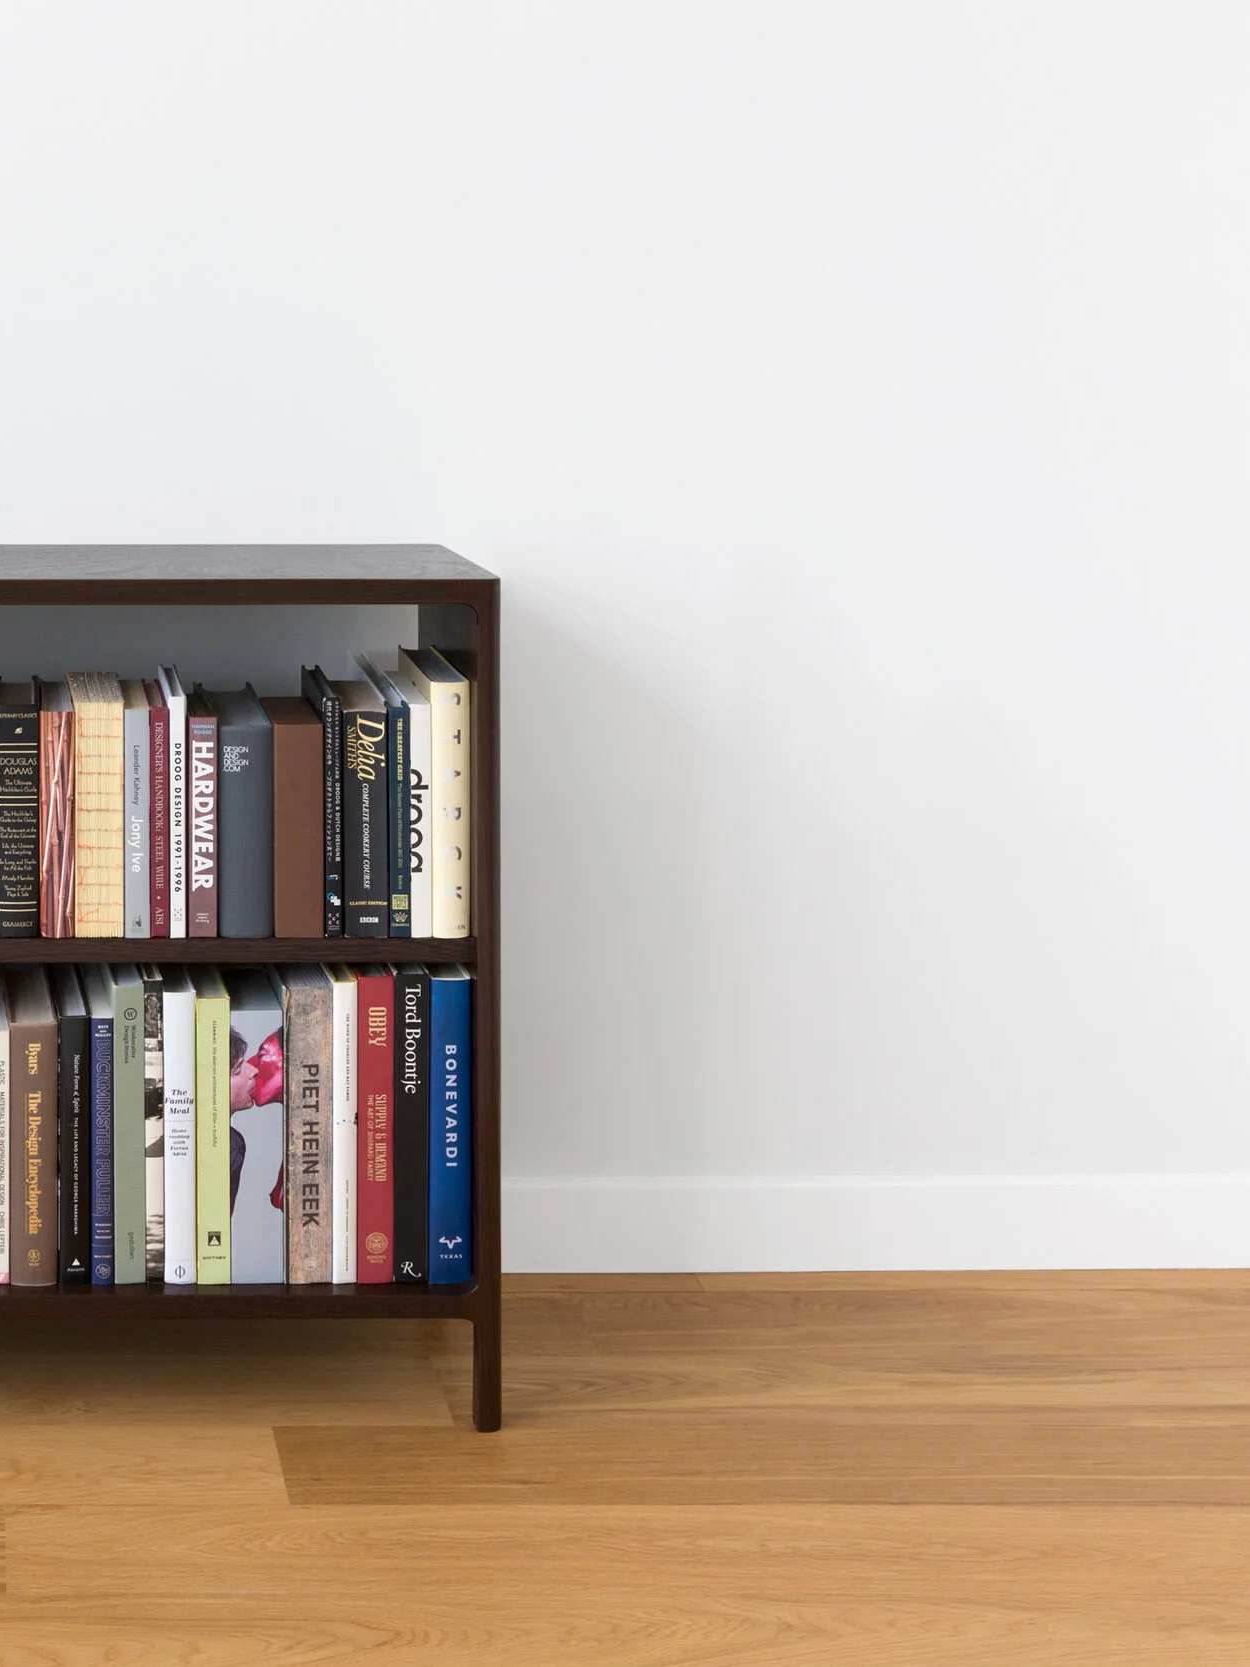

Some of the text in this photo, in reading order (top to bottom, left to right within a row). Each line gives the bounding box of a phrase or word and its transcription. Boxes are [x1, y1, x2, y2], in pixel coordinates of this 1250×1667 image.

[131, 745, 141, 805] Leander Kahney
[224, 752, 239, 760] AND
[347, 726, 356, 769] SMITH'S
[356, 715, 385, 780] Delia
[155, 722, 164, 925] DESIGNER'S HANDBOOK: STEEL WIRE AISI
[174, 743, 183, 893] DROOG DESIGN 1991-1996
[193, 741, 214, 891] HARDWEAR
[439, 693, 461, 899] STARCK
[128, 816, 144, 873] Jony Ive
[368, 1006, 387, 1047] OBEY
[400, 984, 422, 1094] Tord Boontje
[96, 1040, 110, 1155] BUCKMINSTER
[375, 1094, 386, 1128] SUPPLY
[445, 1045, 457, 1167] BONEVARDI
[25, 1043, 41, 1234] Byars The Design Encyclopedia
[302, 1064, 319, 1227] PIET HEIN EEK
[375, 1143, 386, 1181] DEMAND
[96, 1159, 110, 1214] FULLER
[128, 1232, 136, 1259] gestalten
